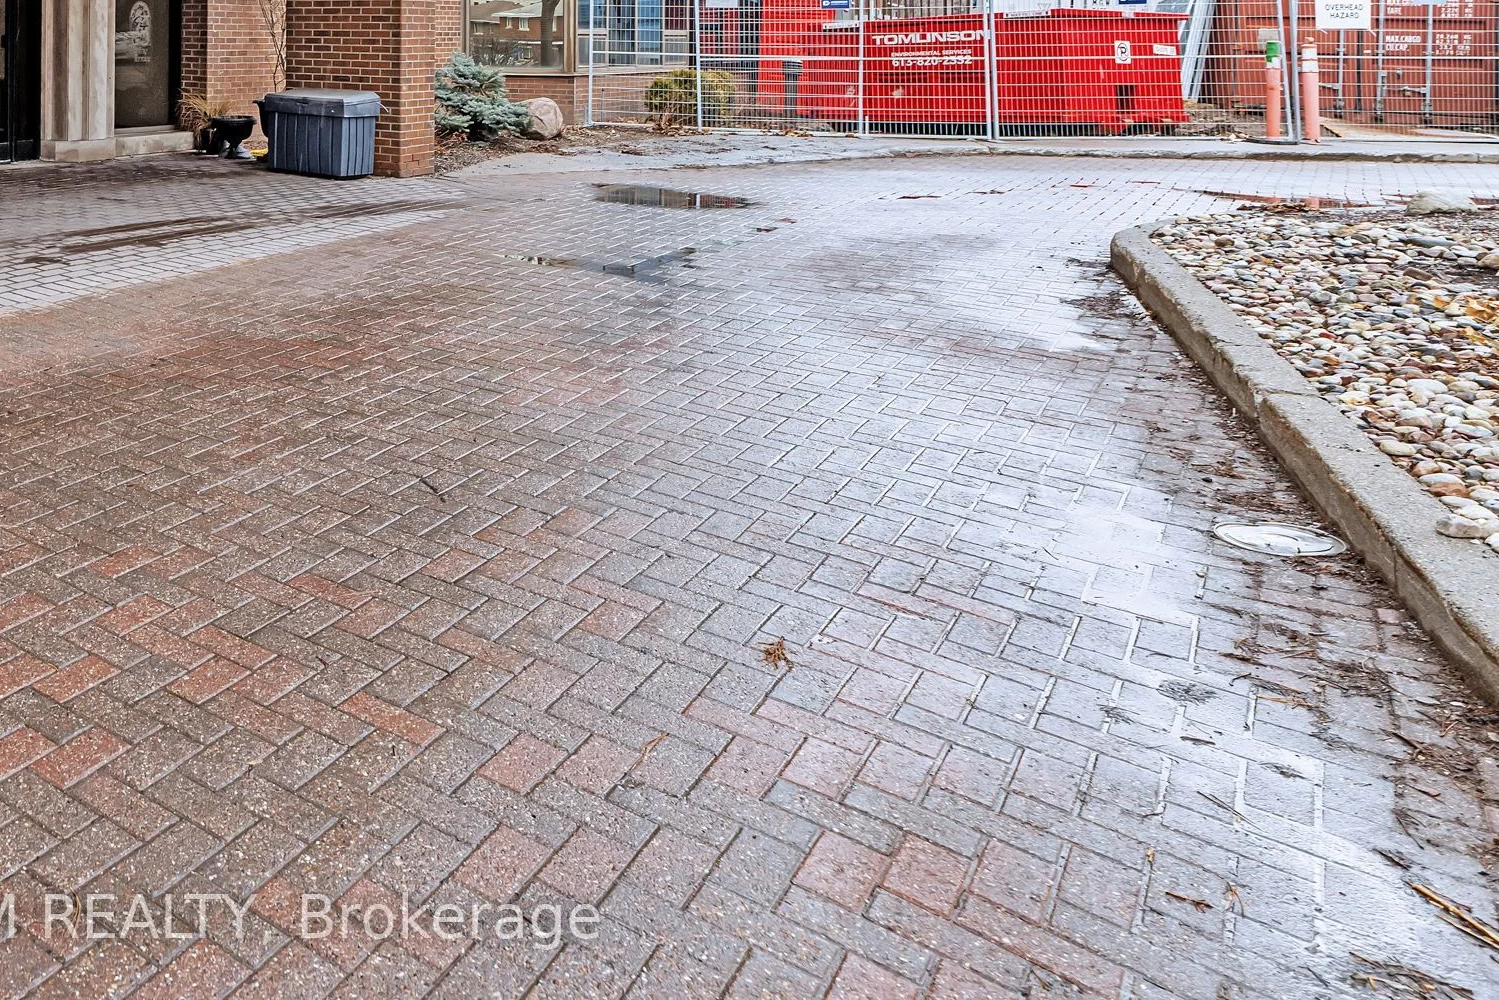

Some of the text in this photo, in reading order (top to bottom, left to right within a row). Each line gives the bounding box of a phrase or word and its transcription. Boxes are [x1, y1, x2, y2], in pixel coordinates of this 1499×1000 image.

[1324, 3, 1363, 11] OVERHEAD
[871, 29, 991, 45] TOMLINSON
[891, 48, 972, 58] ENVIRONMENTAL SERVICES
